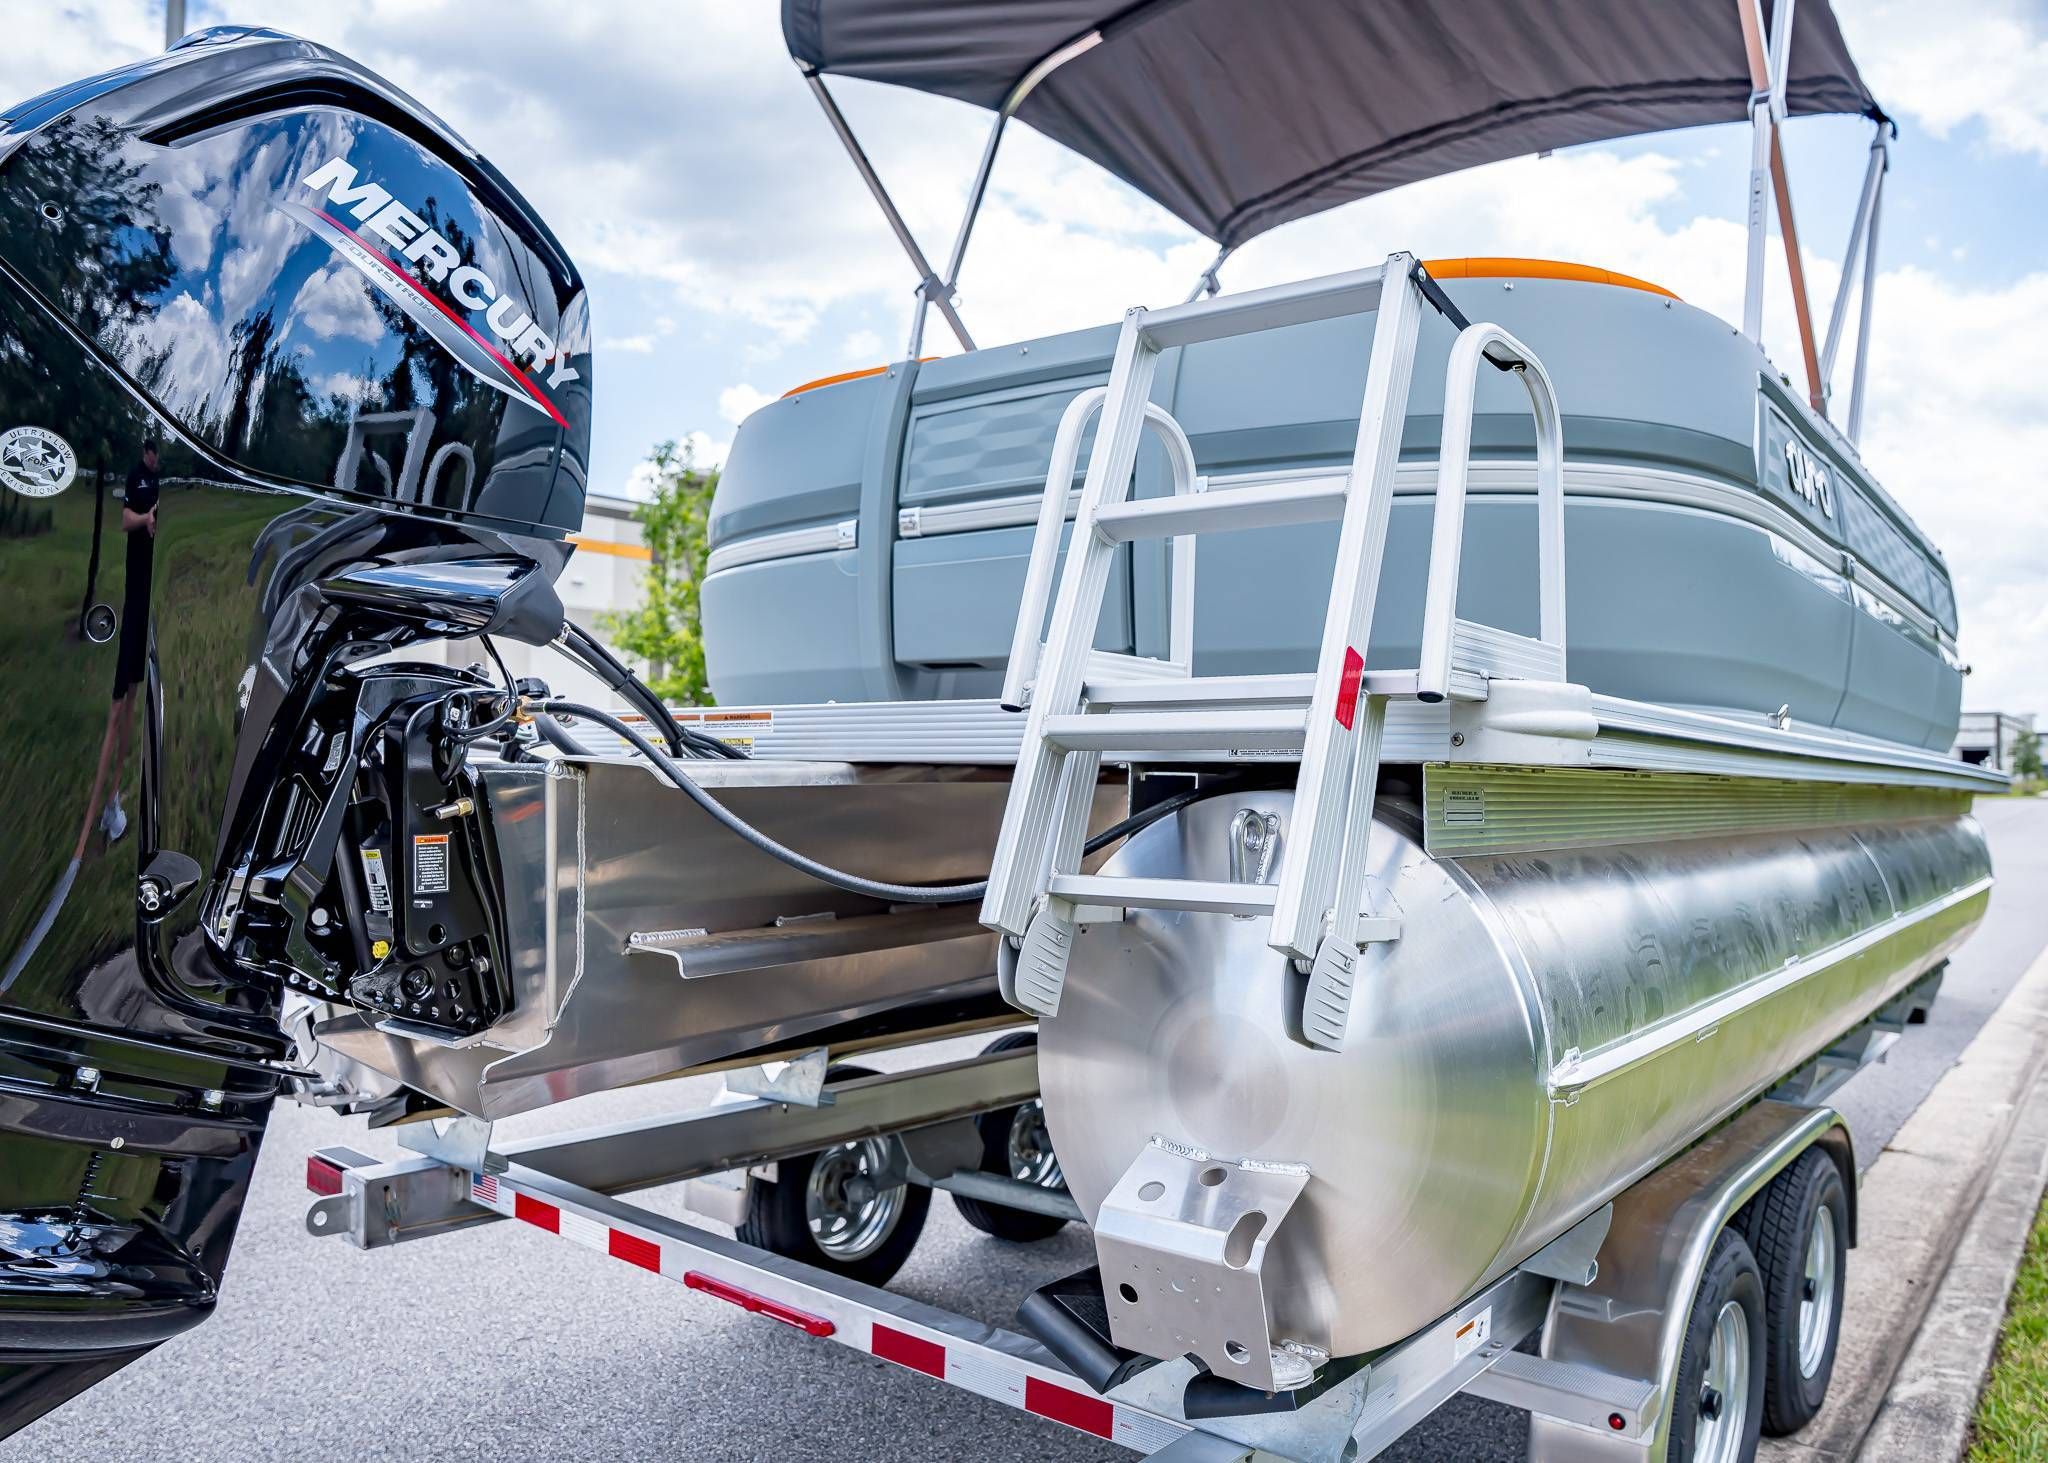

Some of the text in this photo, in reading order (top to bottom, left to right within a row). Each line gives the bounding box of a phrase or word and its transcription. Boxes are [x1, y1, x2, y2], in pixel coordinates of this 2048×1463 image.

[302, 156, 580, 390] MERCURY
[336, 237, 442, 321] FOURSTROKE
[9, 429, 72, 459] ULTRA LOW
